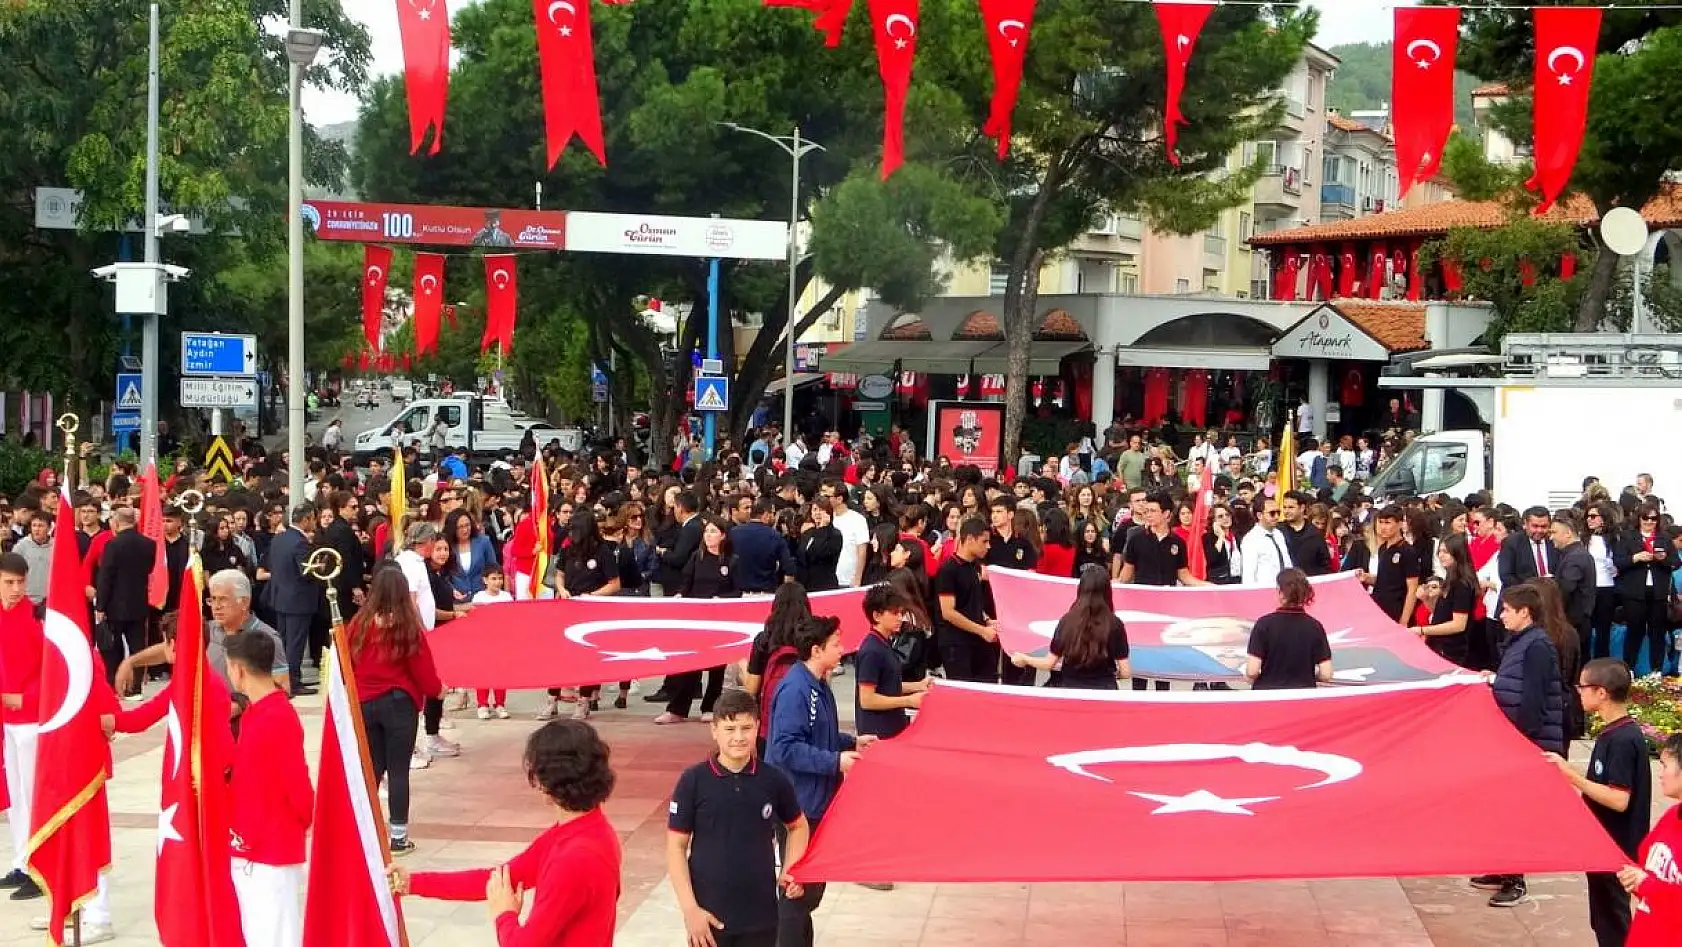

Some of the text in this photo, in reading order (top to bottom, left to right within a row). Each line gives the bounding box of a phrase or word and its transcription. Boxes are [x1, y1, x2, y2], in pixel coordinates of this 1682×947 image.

[422, 224, 472, 233] Kutlu Olsun
[640, 223, 677, 235] Osman
[1299, 330, 1353, 352] Atapark
[187, 348, 214, 359] Aydın
